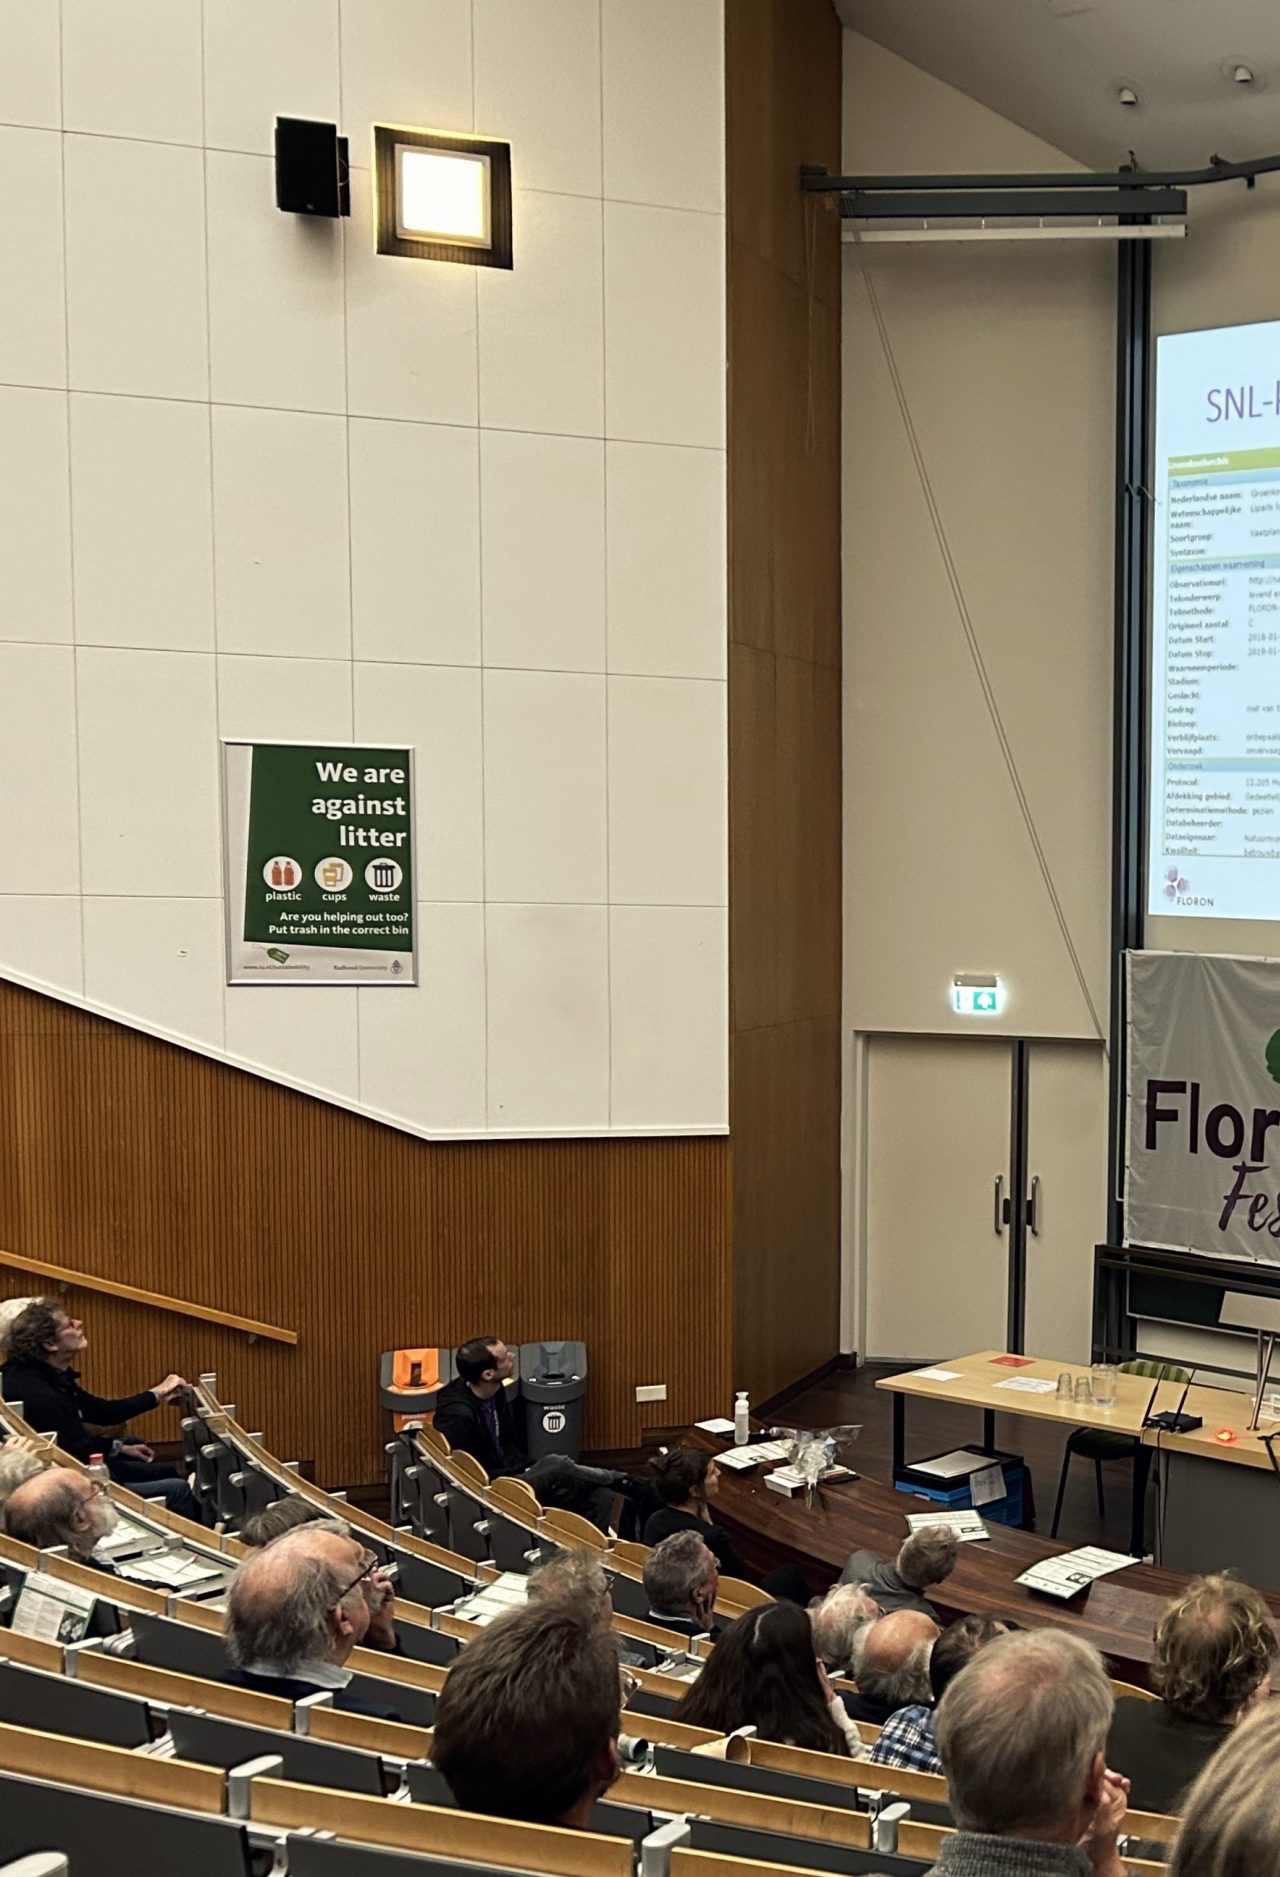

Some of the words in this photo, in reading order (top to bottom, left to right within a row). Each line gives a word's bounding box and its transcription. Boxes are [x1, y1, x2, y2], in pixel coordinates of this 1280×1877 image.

[1171, 493, 1218, 504] Nederlandse
[1170, 506, 1242, 519] Wetenschappelijke
[1171, 562, 1222, 573] Eigenschappen
[1249, 590, 1272, 599] levend
[1168, 635, 1193, 644] Datum
[1168, 650, 1193, 659] Datum
[315, 762, 358, 782] We
[364, 767, 405, 783] are
[312, 794, 406, 820] against
[339, 825, 407, 847] litter
[265, 890, 302, 902] plastic
[322, 893, 348, 903] cups
[369, 892, 401, 902] waste
[1177, 896, 1214, 907] FLORON
[280, 912, 300, 922] Are
[301, 914, 322, 925] you
[324, 912, 364, 923] helping
[365, 914, 384, 922] out
[385, 913, 409, 922] too?
[269, 925, 288, 934] Put
[289, 925, 318, 934] trash
[319, 925, 330, 934] in
[332, 925, 351, 934] the
[351, 926, 391, 935] correct
[392, 925, 409, 935] bin
